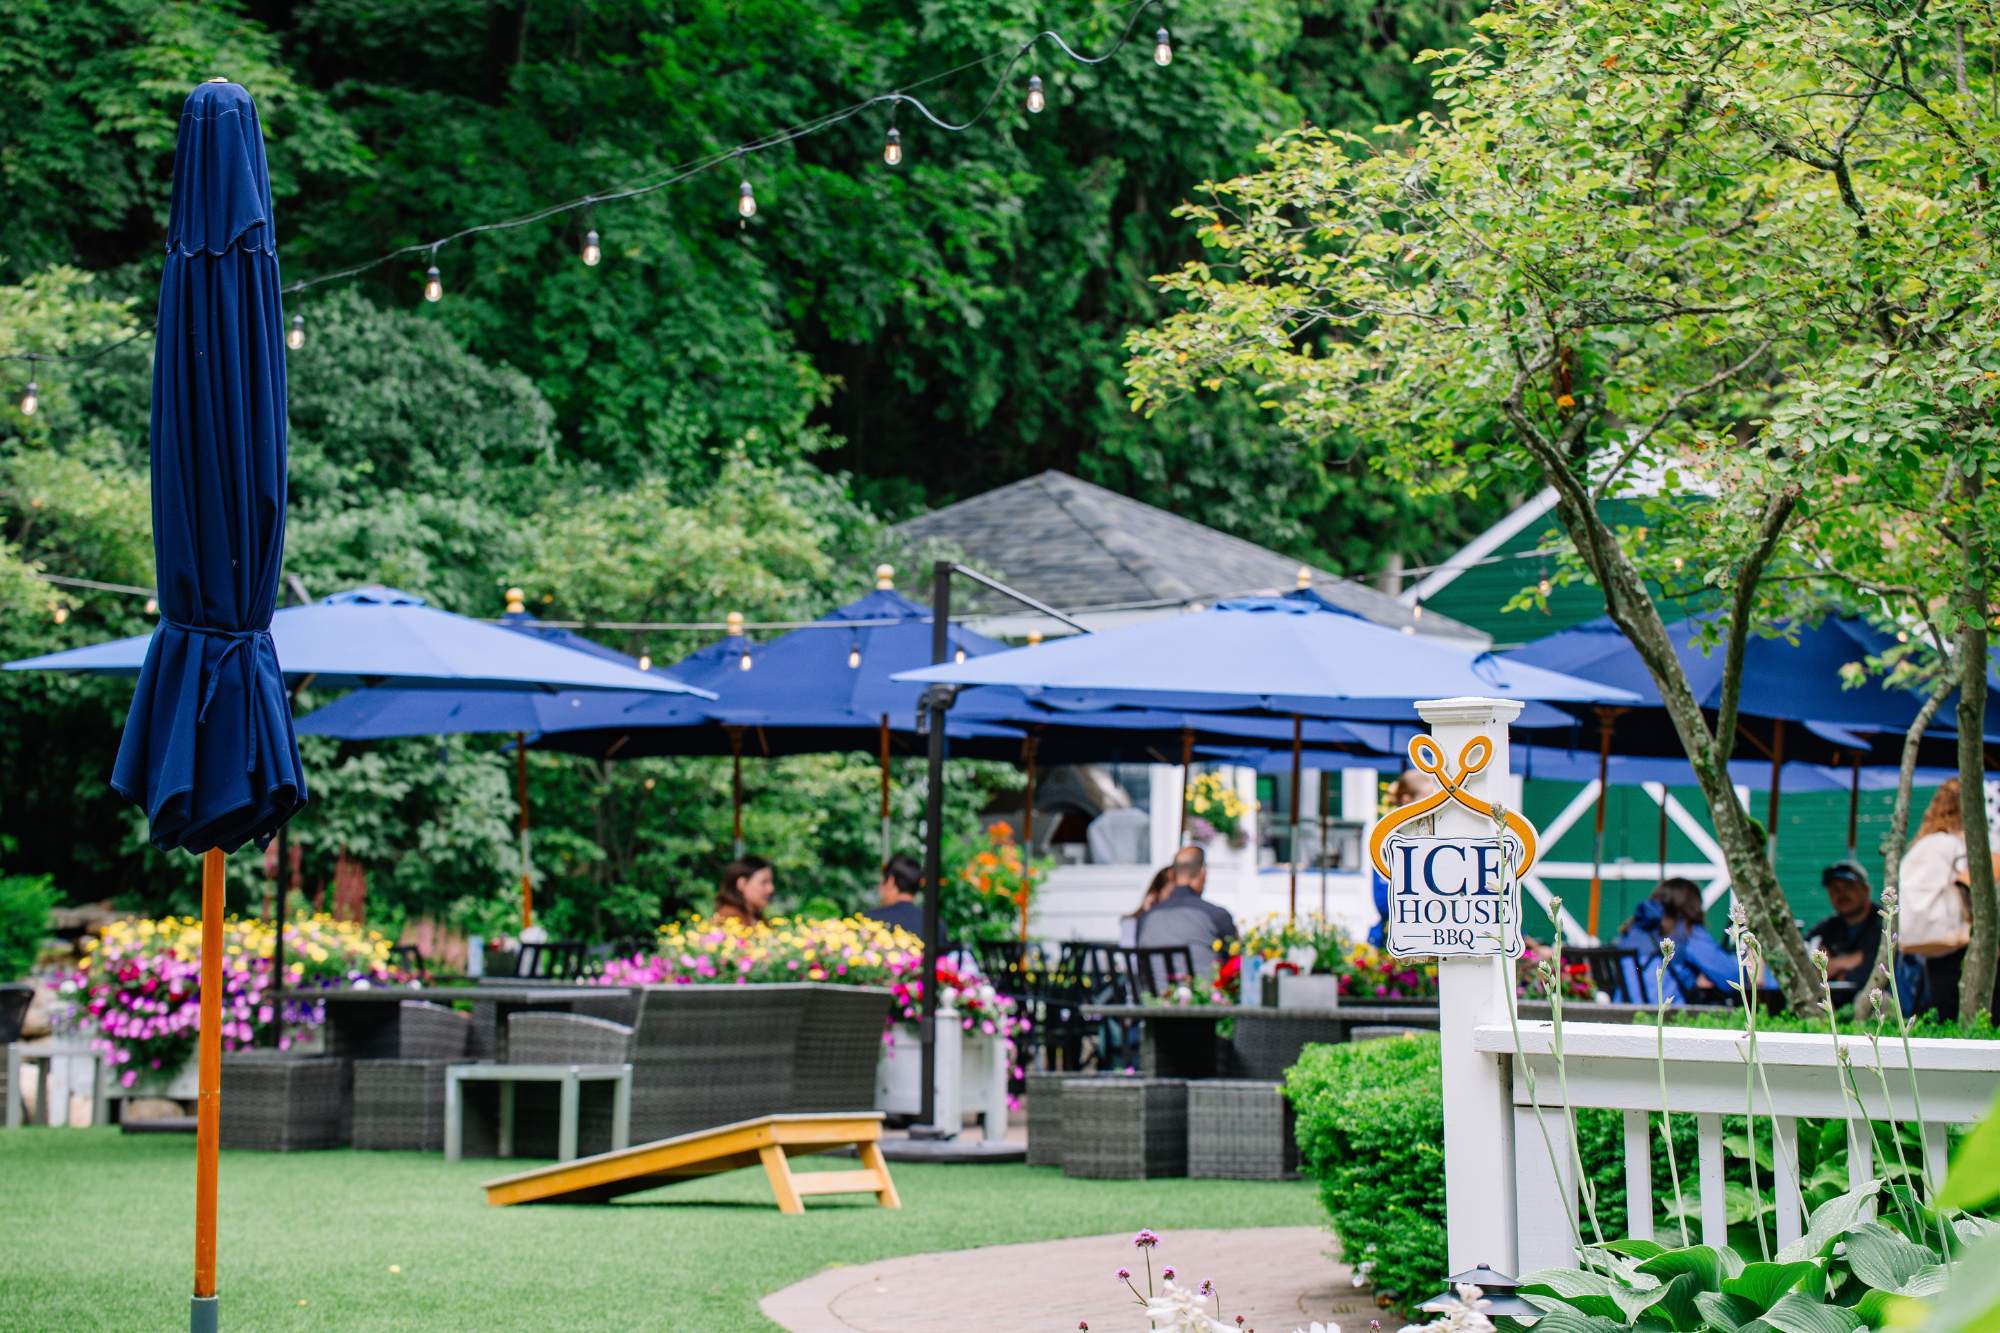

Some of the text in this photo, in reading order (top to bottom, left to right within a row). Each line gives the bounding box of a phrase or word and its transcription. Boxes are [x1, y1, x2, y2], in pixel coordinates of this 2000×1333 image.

[1396, 844, 1511, 896] ICE
[1396, 899, 1511, 925] HOUSE
[1431, 928, 1476, 949] BBQ
